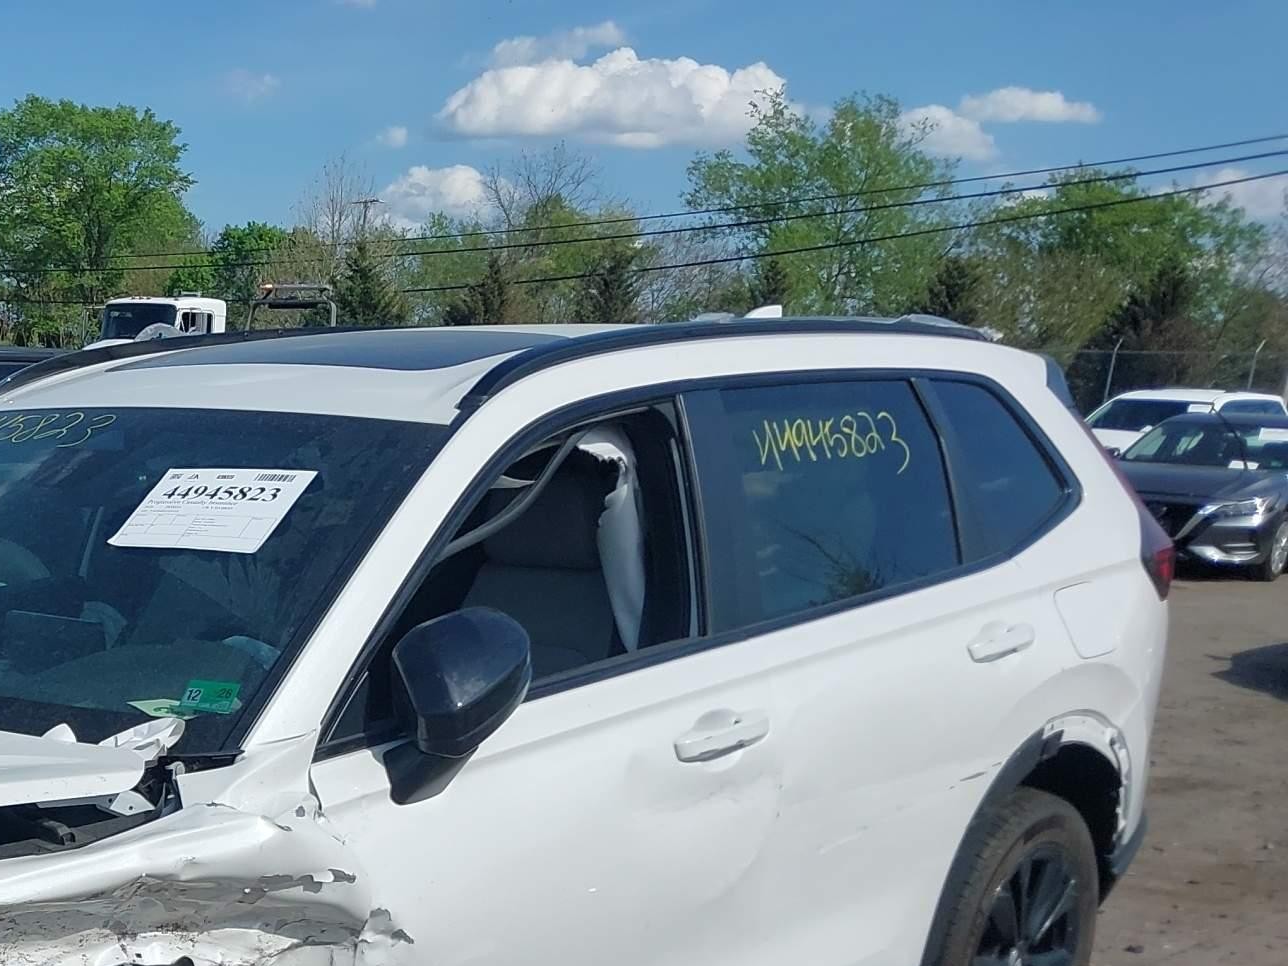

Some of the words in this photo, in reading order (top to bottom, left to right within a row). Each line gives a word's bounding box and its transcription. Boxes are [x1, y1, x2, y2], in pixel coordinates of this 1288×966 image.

[752, 411, 910, 475] 44945823
[162, 484, 282, 502] 44945823
[187, 688, 202, 702] 12
